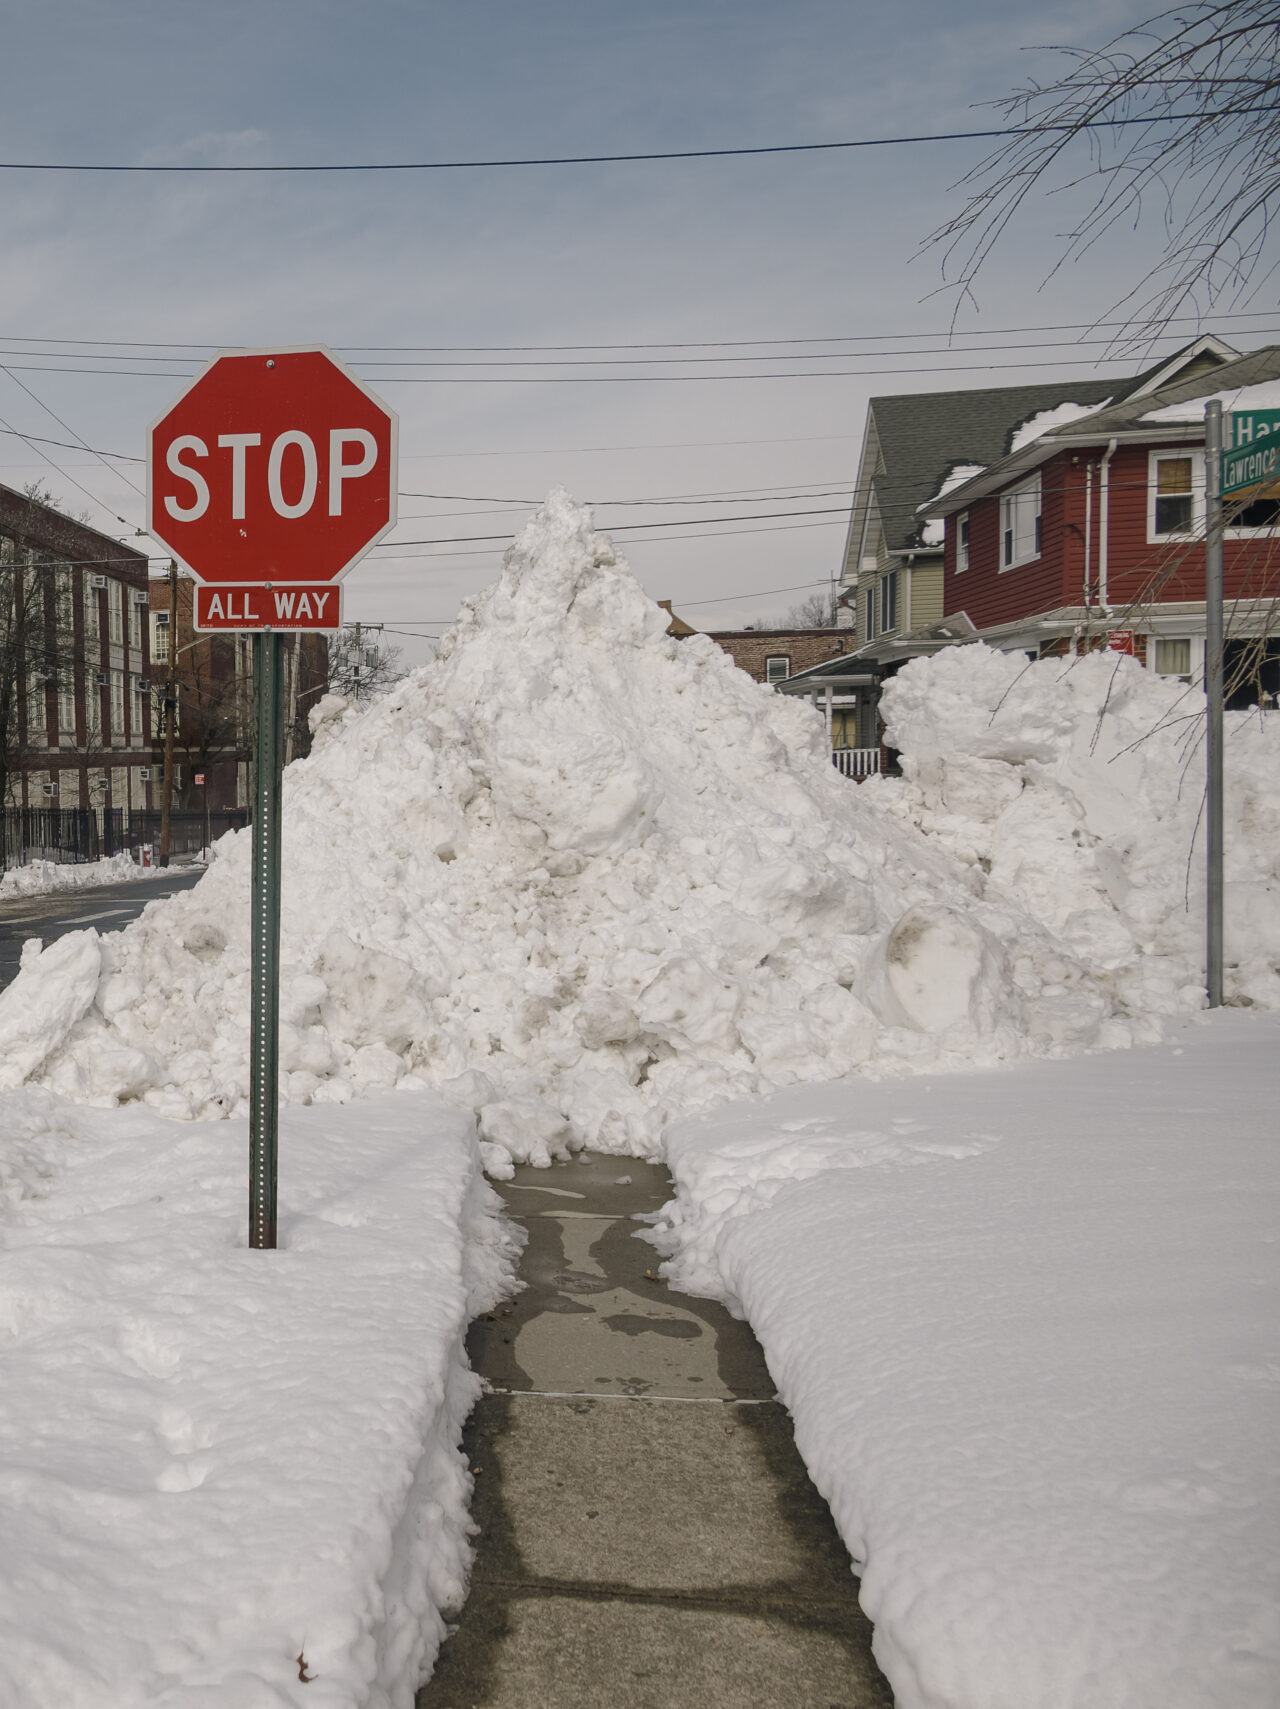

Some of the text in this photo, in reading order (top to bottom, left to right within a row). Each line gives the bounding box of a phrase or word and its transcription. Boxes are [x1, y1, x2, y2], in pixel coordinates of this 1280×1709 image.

[164, 427, 378, 522] STOP
[1224, 447, 1276, 488] Lawrence
[207, 592, 330, 620] ALL WAY
